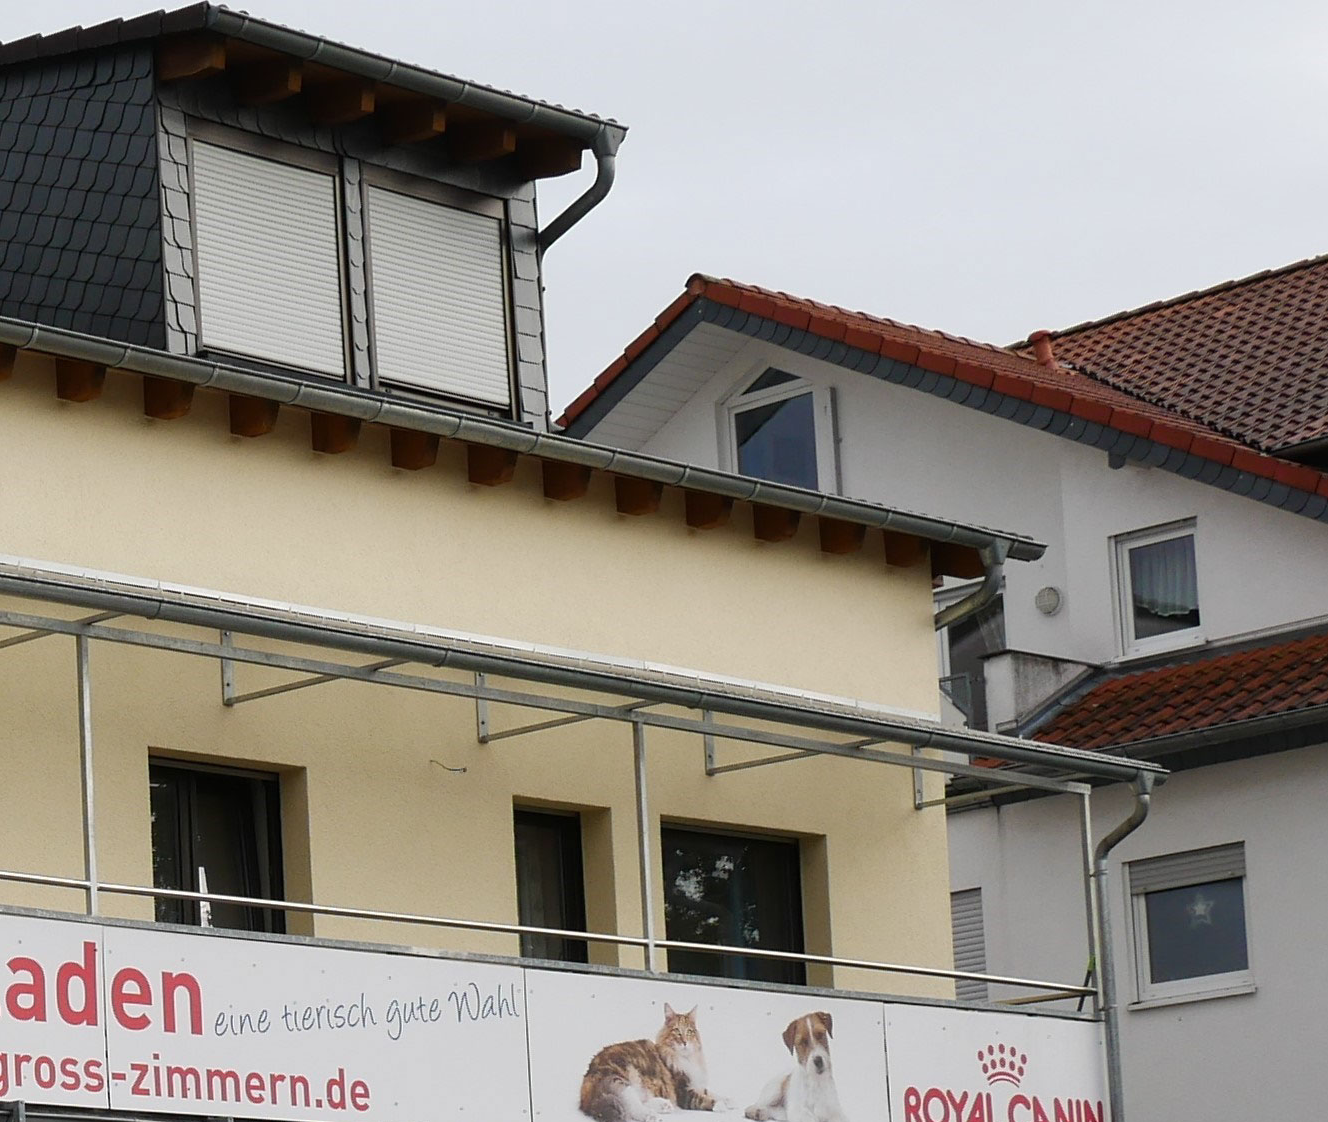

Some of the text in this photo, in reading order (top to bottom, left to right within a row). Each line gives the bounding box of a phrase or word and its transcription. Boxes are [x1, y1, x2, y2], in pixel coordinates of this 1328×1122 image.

[214, 982, 521, 1040] eine tierisch gute Wahl
